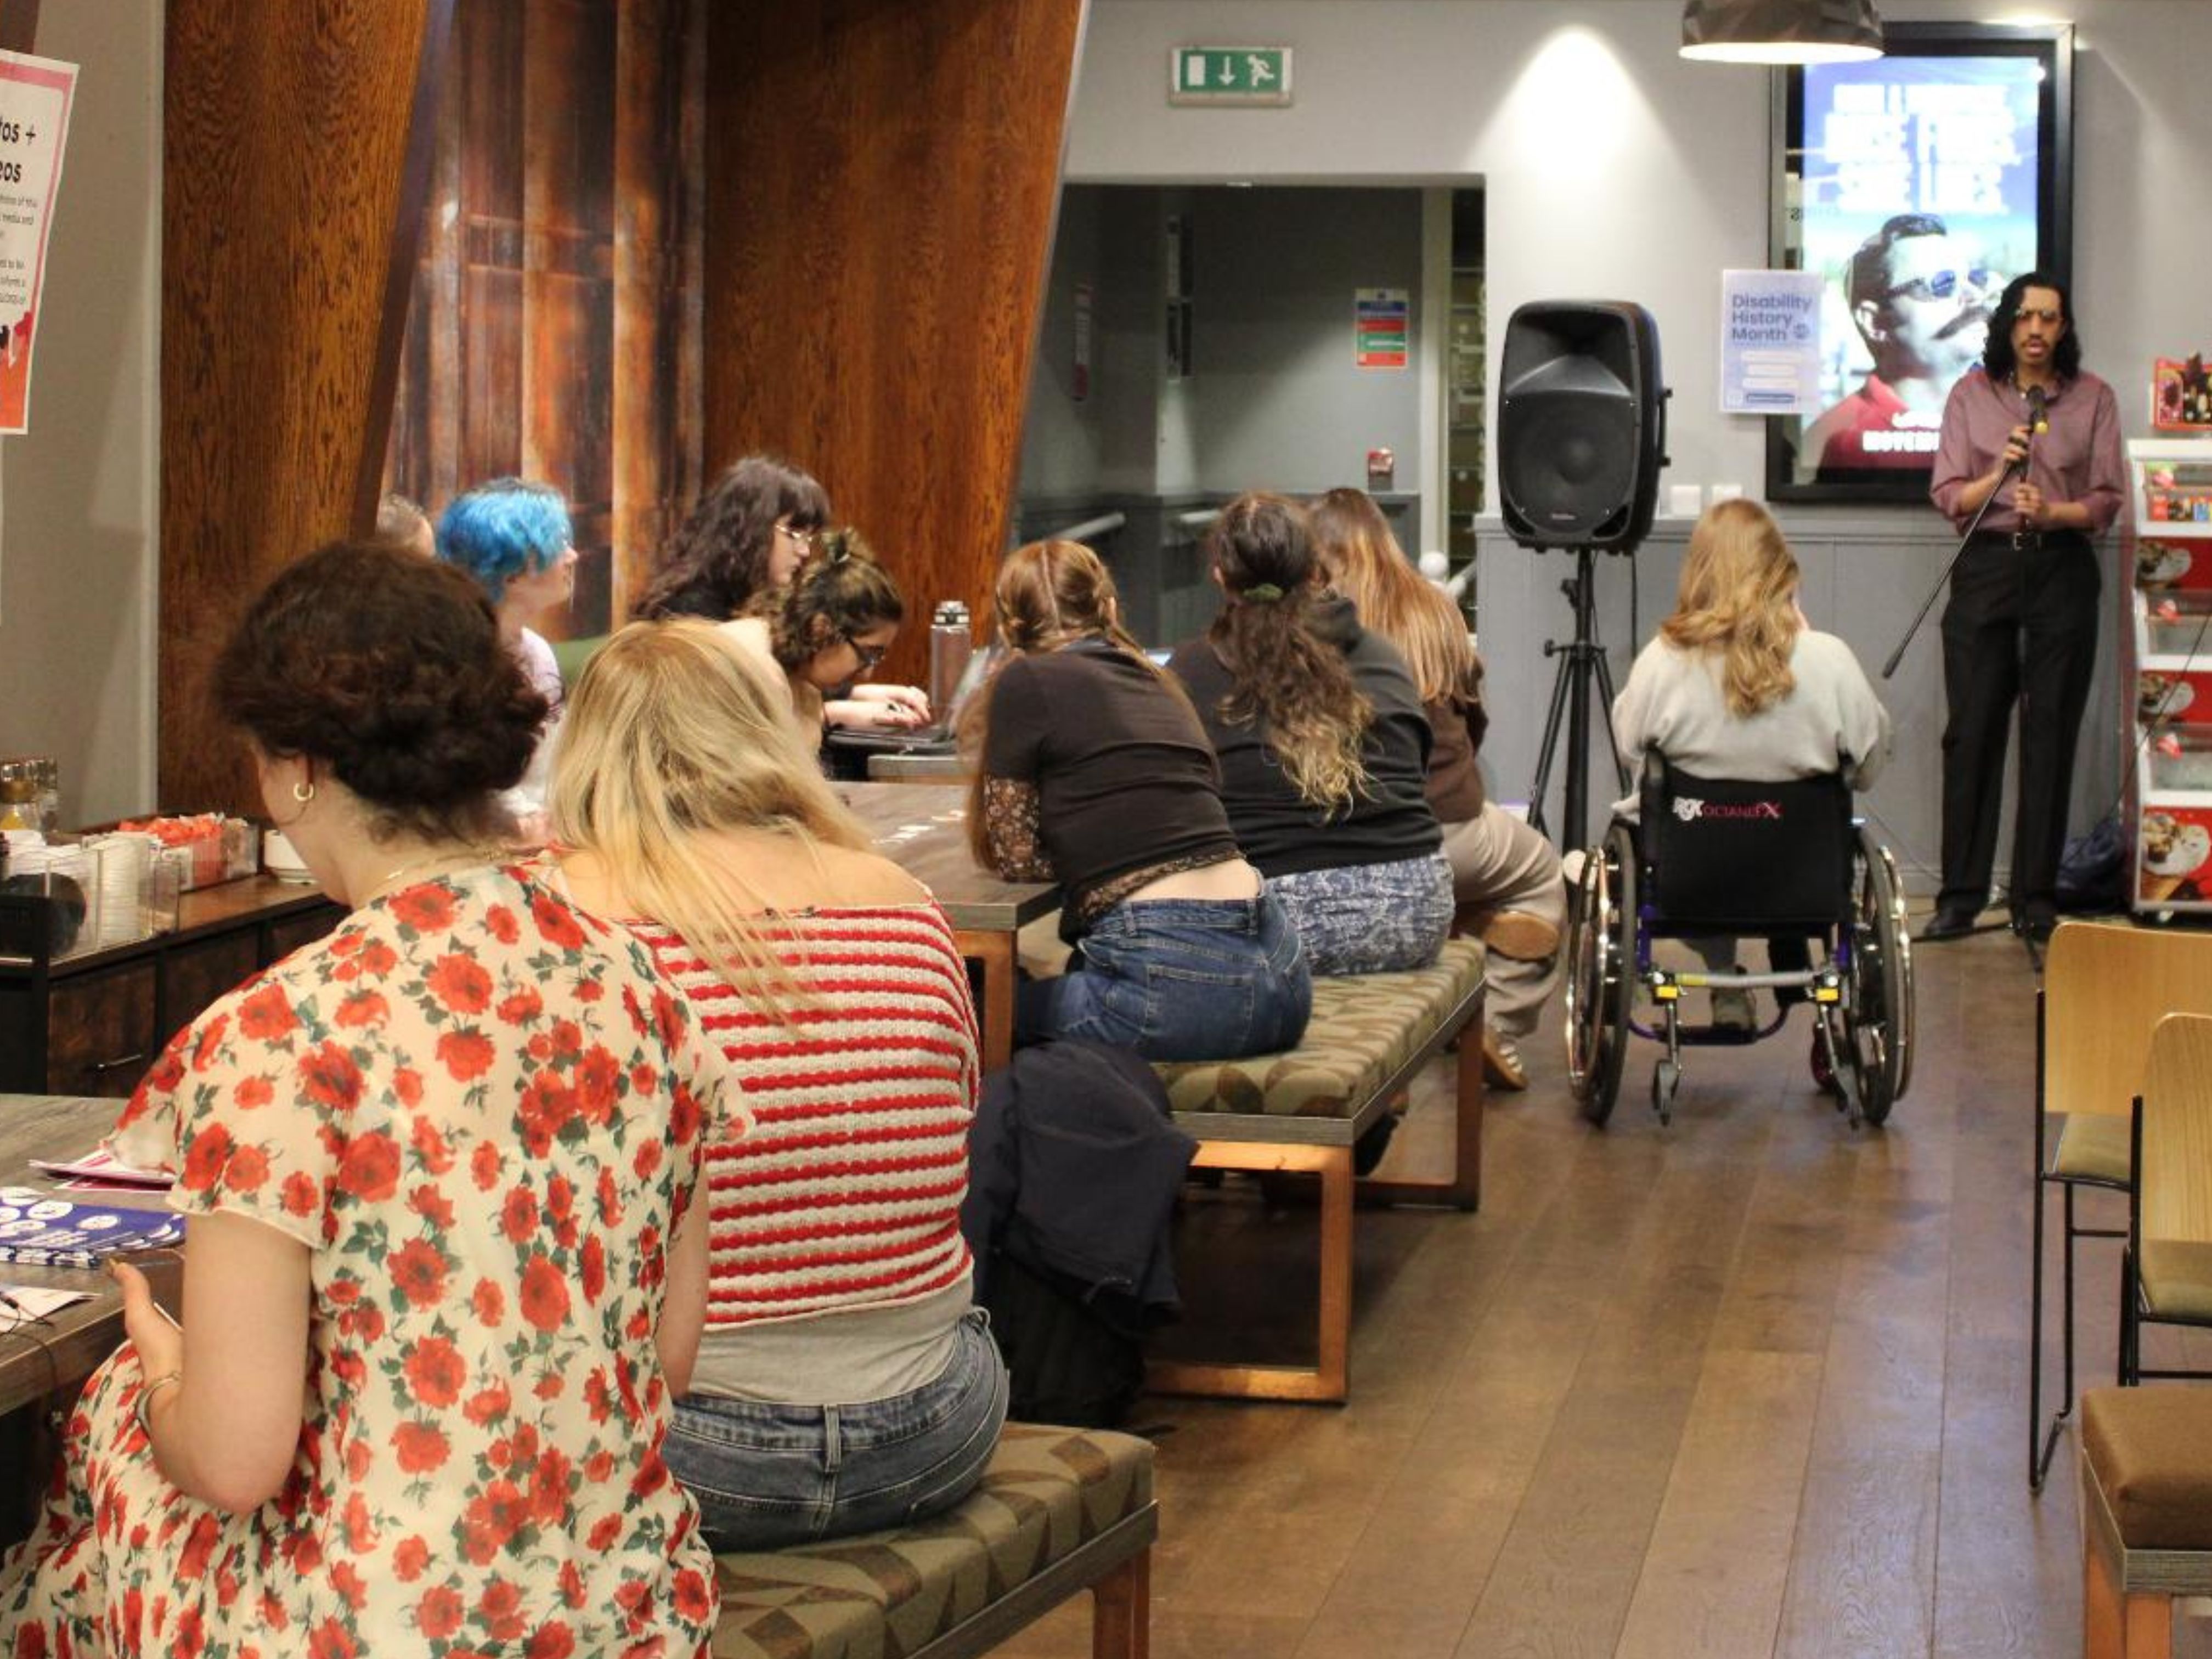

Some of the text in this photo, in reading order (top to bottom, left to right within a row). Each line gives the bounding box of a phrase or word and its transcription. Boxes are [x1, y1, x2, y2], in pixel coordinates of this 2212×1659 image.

[1732, 293, 1813, 313] Disability
[1732, 312, 1792, 329] History
[1732, 328, 1787, 341] Month
